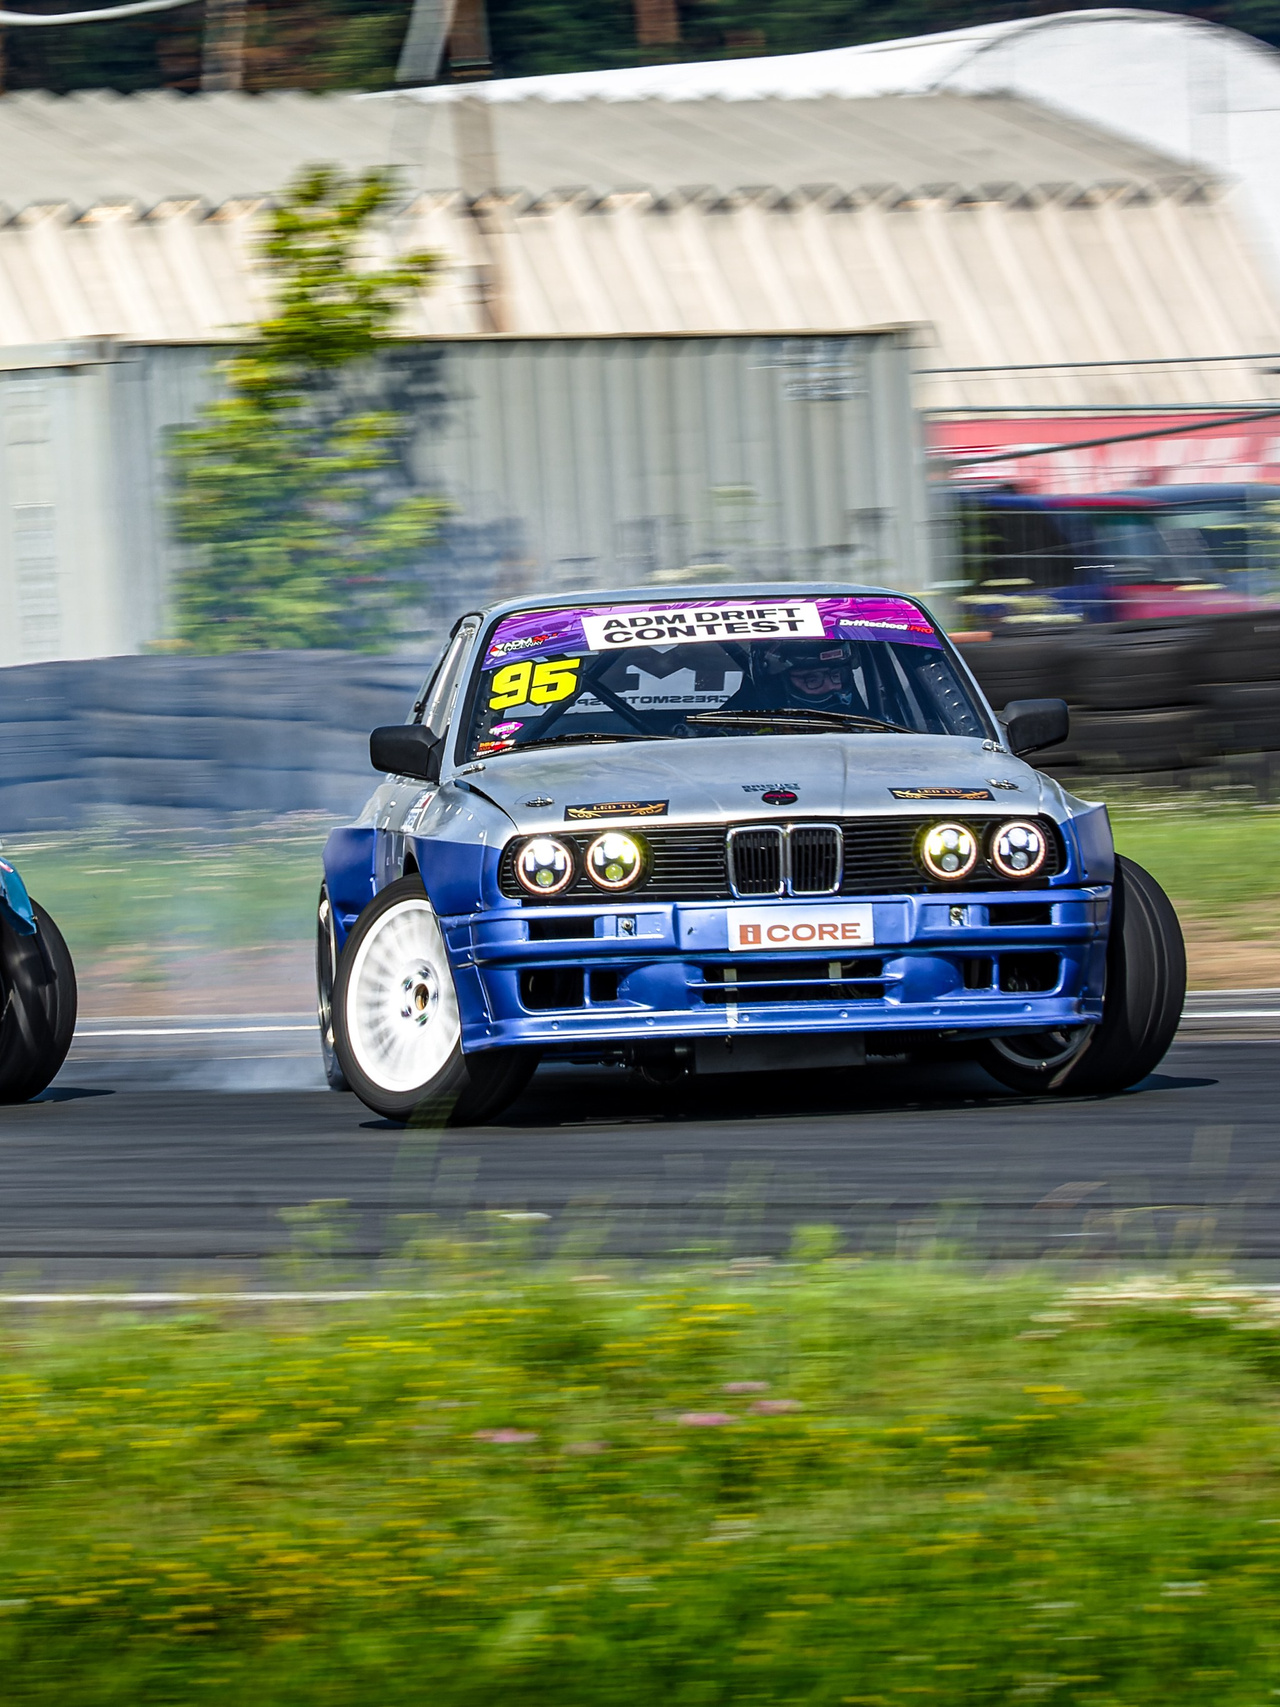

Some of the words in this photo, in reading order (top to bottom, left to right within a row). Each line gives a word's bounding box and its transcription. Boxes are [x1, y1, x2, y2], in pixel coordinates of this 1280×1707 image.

[603, 613, 687, 631] ADM
[693, 607, 801, 623] DRIFT
[604, 619, 805, 644] CONTEST
[489, 658, 581, 711] 95
[766, 922, 861, 943] CORE
